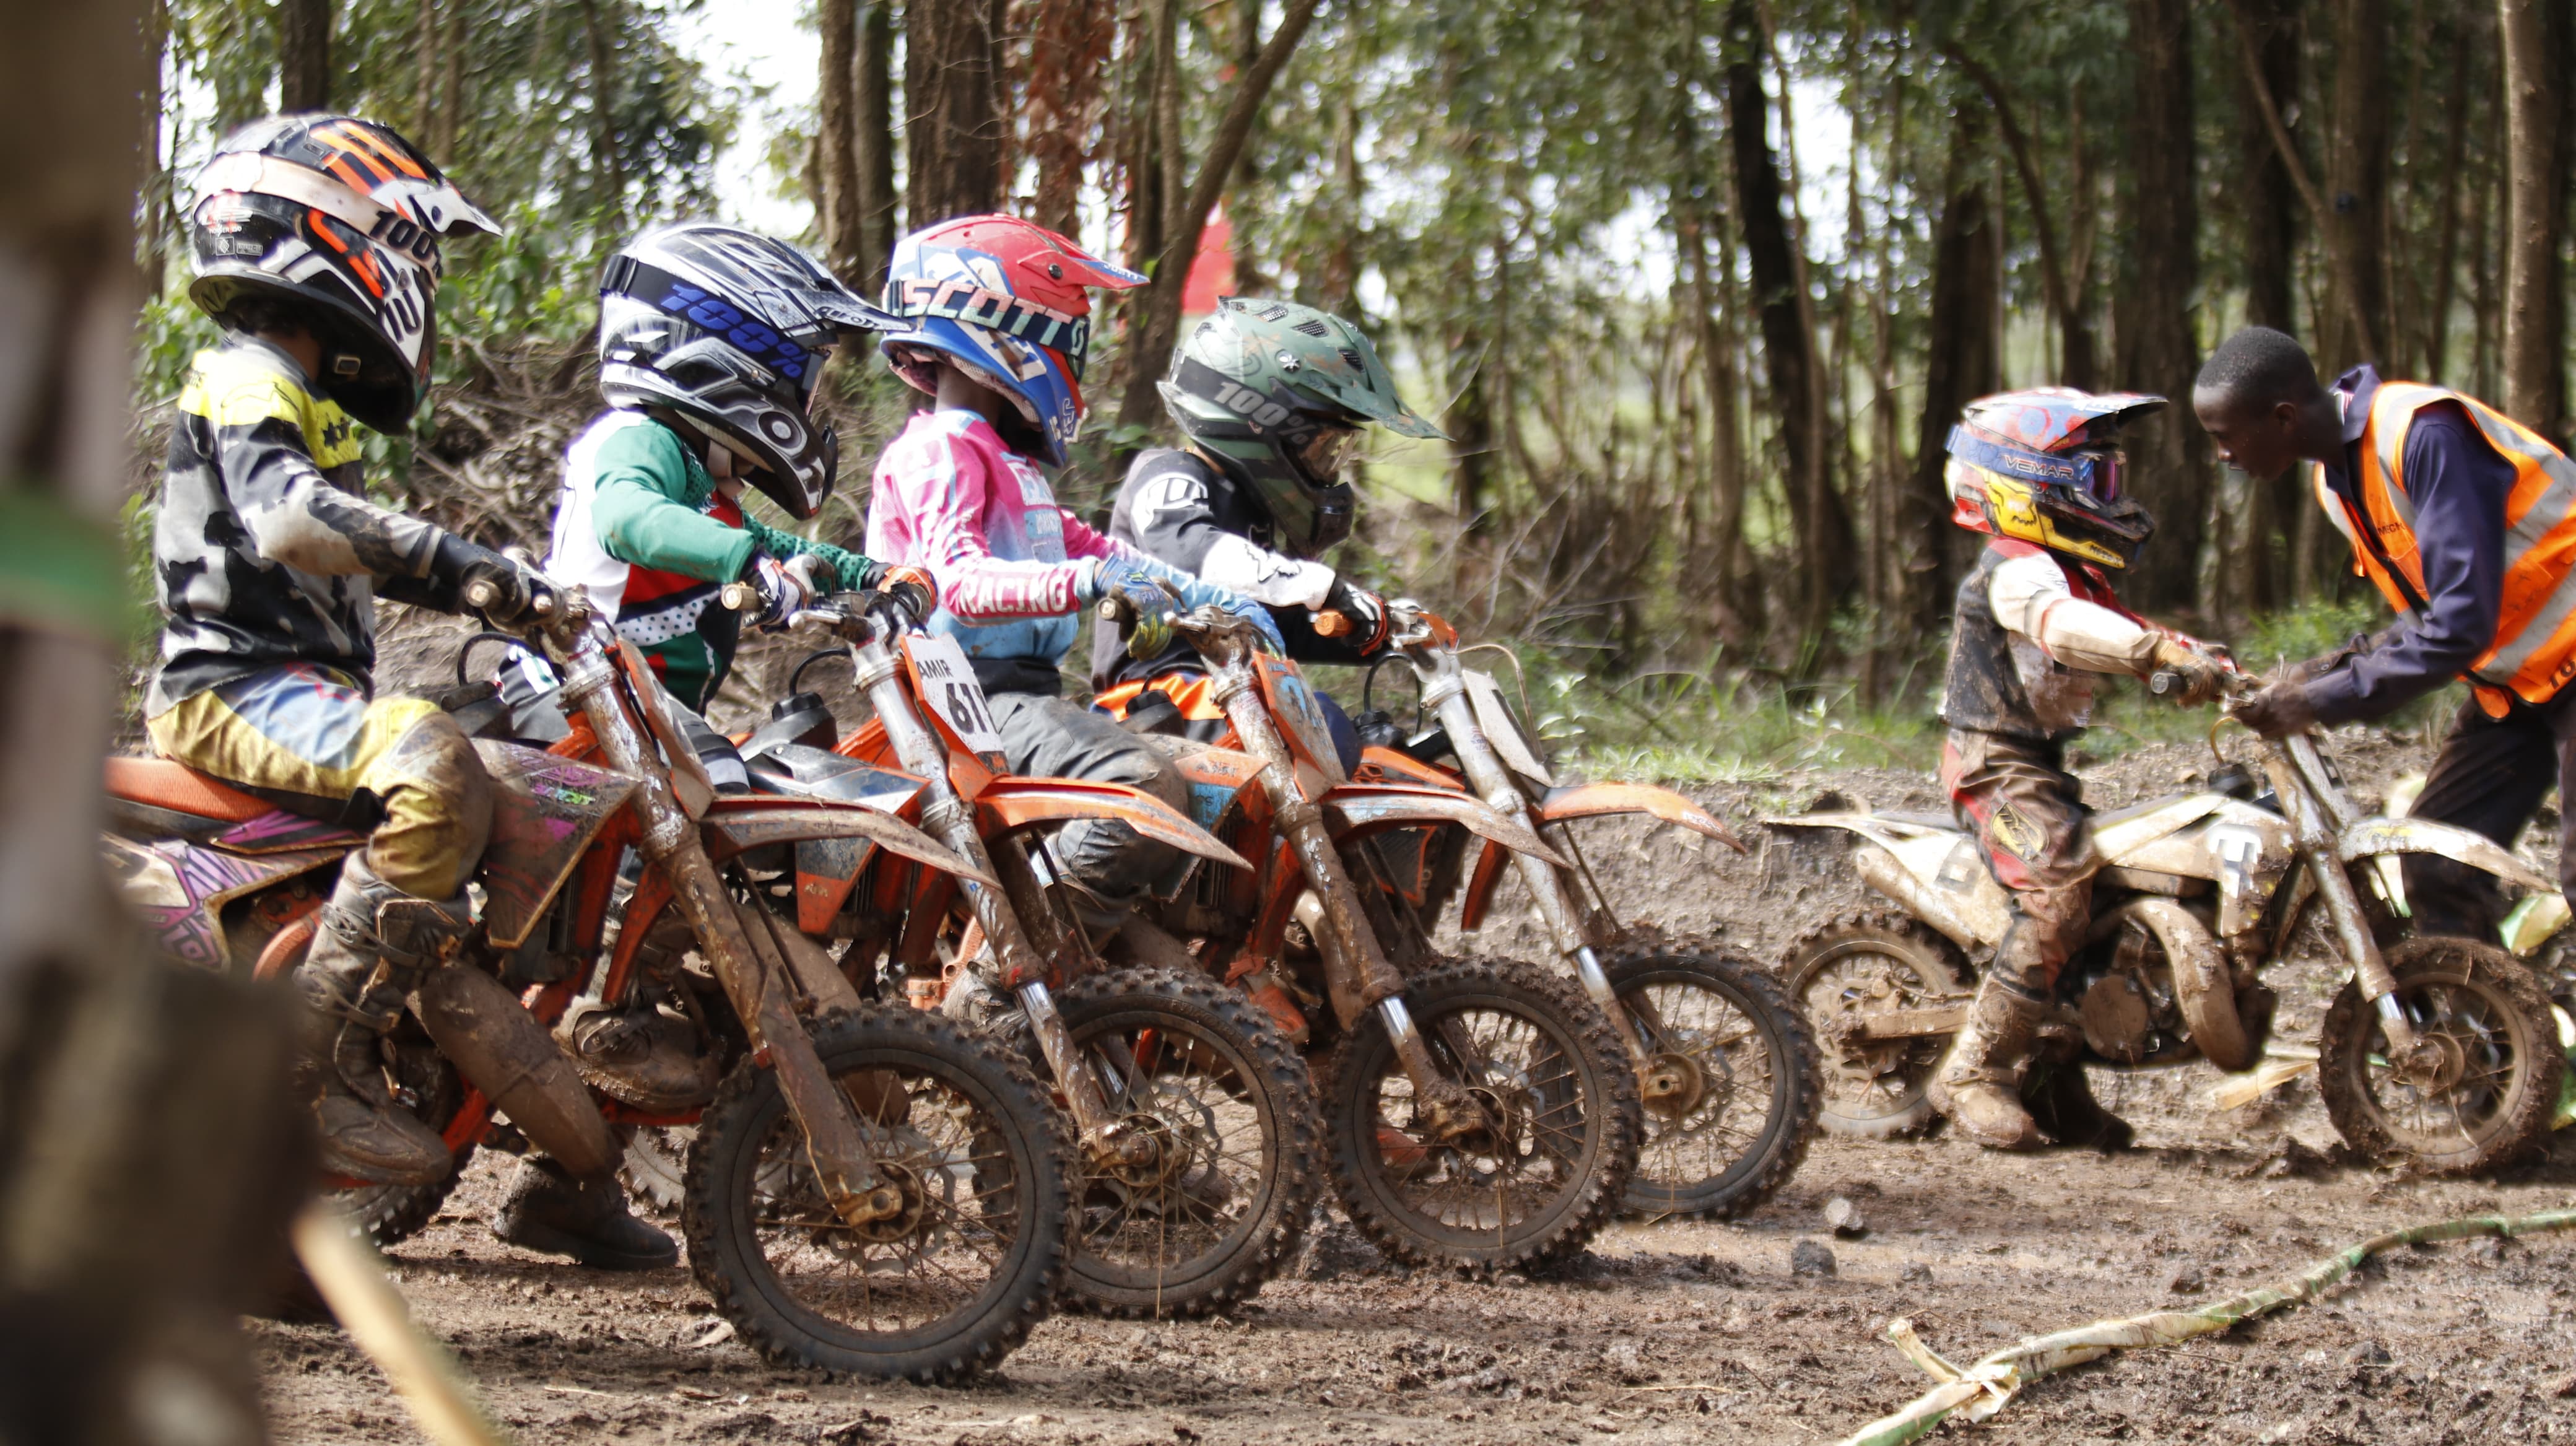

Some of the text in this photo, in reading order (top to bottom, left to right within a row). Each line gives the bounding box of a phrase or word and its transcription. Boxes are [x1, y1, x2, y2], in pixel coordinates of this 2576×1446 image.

[661, 284, 811, 378] 100%
[1214, 381, 1317, 444] 100%
[2004, 455, 2073, 479] VEMAR
[960, 573, 1068, 614] RACING
[916, 659, 954, 679] AMIR
